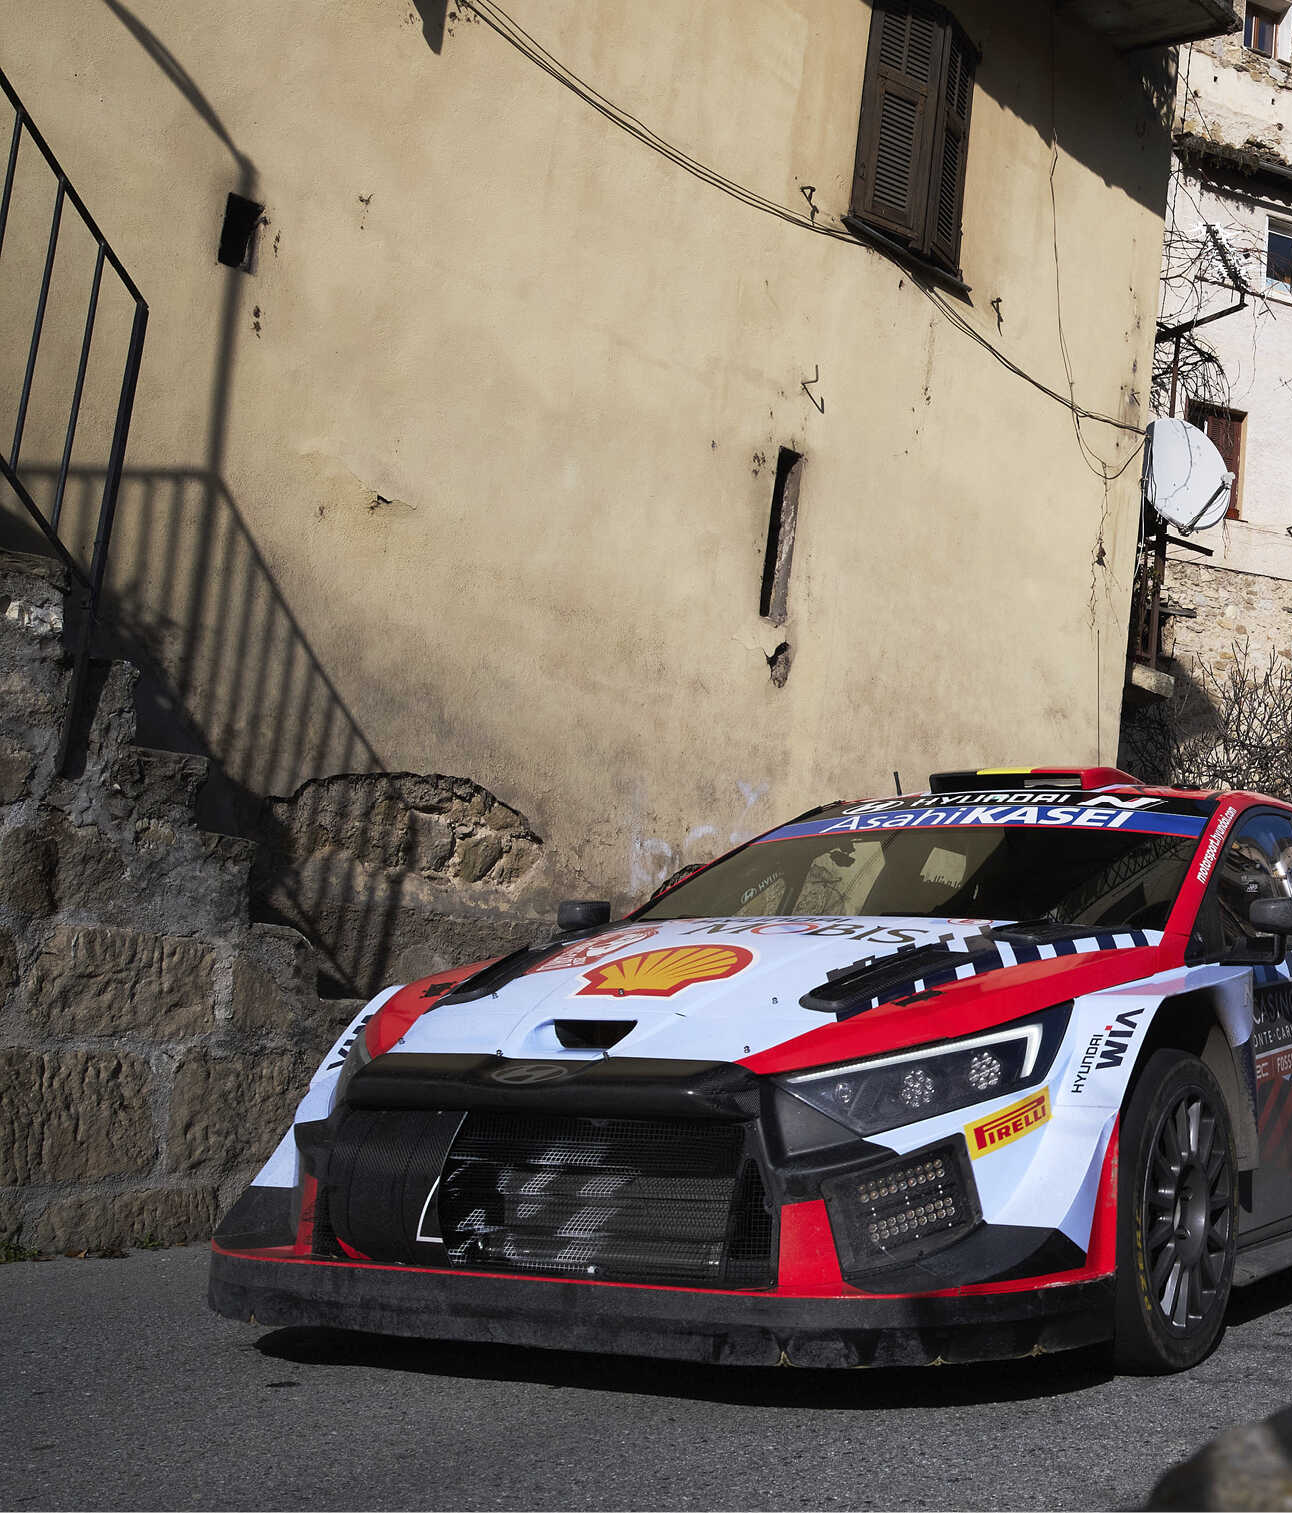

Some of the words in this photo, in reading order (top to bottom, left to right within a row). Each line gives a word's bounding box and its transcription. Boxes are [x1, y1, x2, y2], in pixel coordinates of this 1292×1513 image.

[818, 805, 1135, 834] AsahiKASEI
[910, 792, 1070, 807] HYUNDAI
[1196, 806, 1237, 884] motorsport.hyundai.com
[682, 922, 930, 943] MOBIS
[1071, 1034, 1104, 1093] HYUNDAI
[973, 1095, 1047, 1151] PIRELLI
